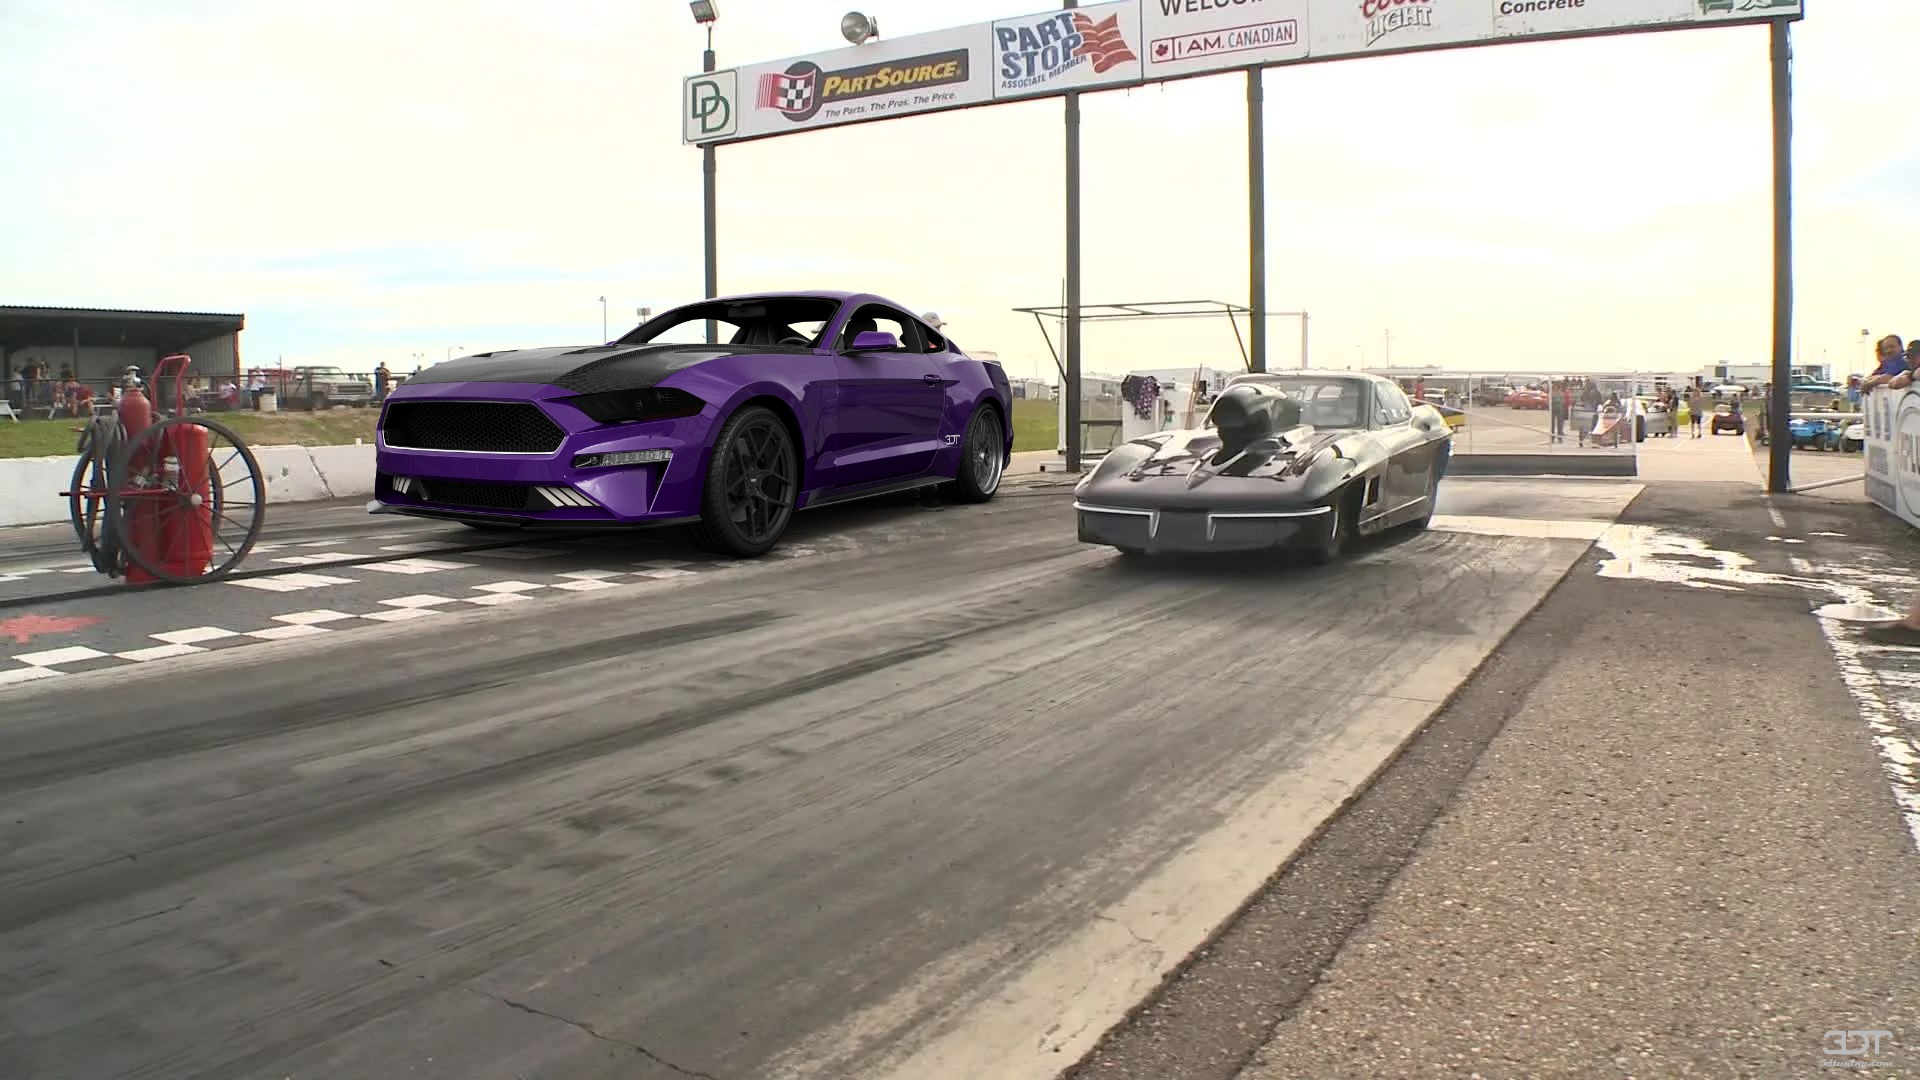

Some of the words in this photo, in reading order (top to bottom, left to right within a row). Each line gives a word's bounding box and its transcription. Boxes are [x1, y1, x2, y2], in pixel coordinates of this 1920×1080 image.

[996, 12, 1075, 51] PART
[1228, 24, 1293, 49] CANADIAN
[1366, 6, 1432, 47] LIGHT
[1001, 33, 1081, 79] STOP
[1001, 74, 1046, 89] ASSOCIATE
[1048, 55, 1087, 79] MEMBER
[825, 110, 841, 119] The
[870, 101, 886, 111] The
[913, 95, 930, 105] The
